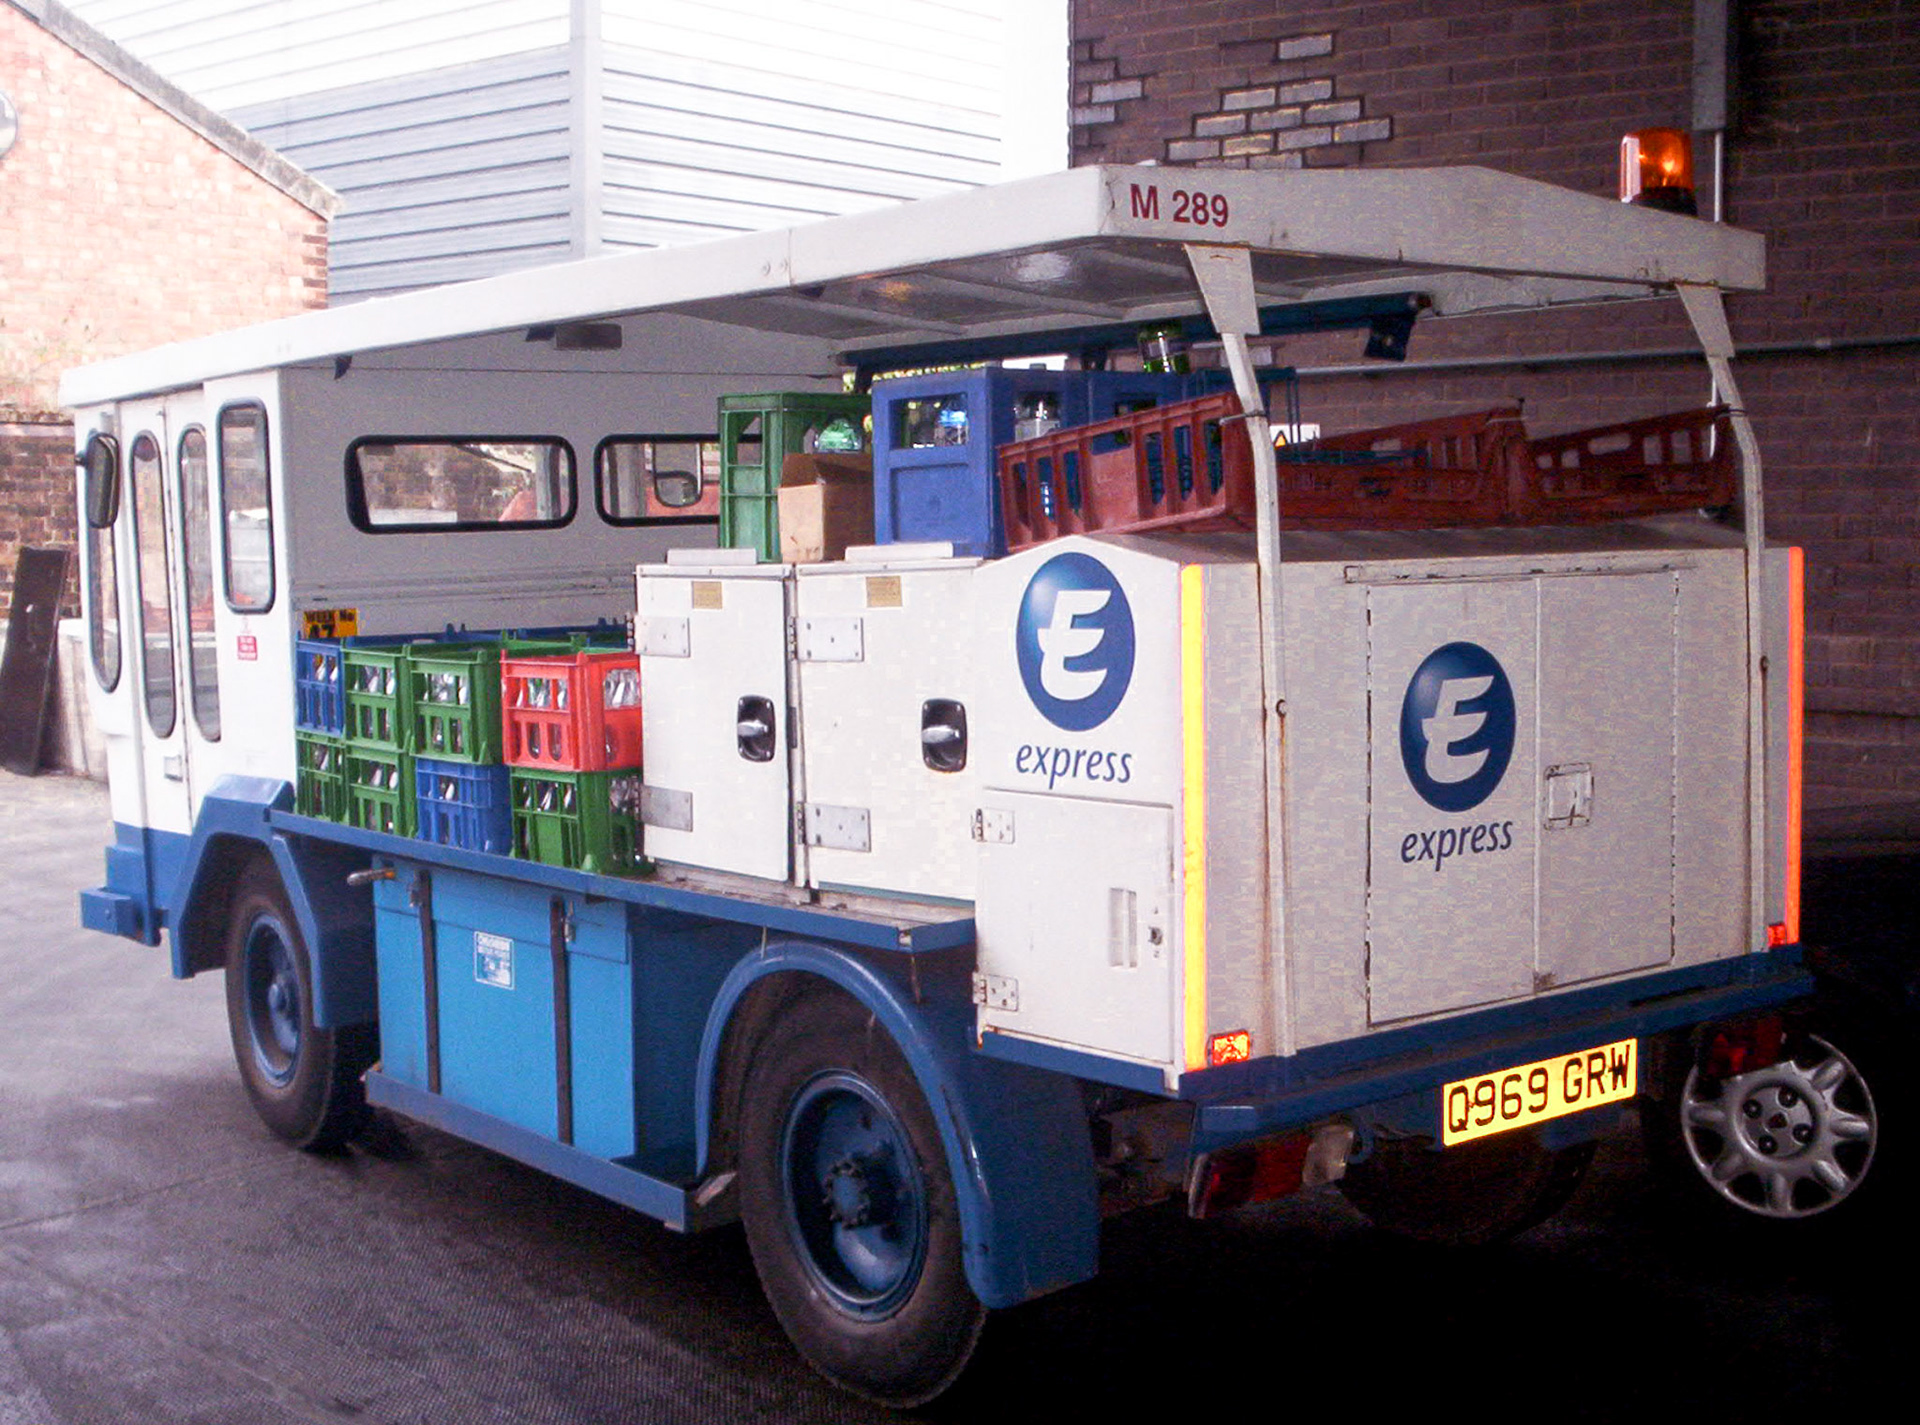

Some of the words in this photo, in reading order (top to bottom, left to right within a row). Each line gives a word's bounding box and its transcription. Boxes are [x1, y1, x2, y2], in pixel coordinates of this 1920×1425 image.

[1130, 183, 1159, 220] M
[1172, 189, 1229, 228] 289
[1015, 743, 1133, 790] express
[1400, 820, 1514, 872] express
[1448, 1066, 1549, 1133] Q969
[1563, 1044, 1631, 1104] GRW
